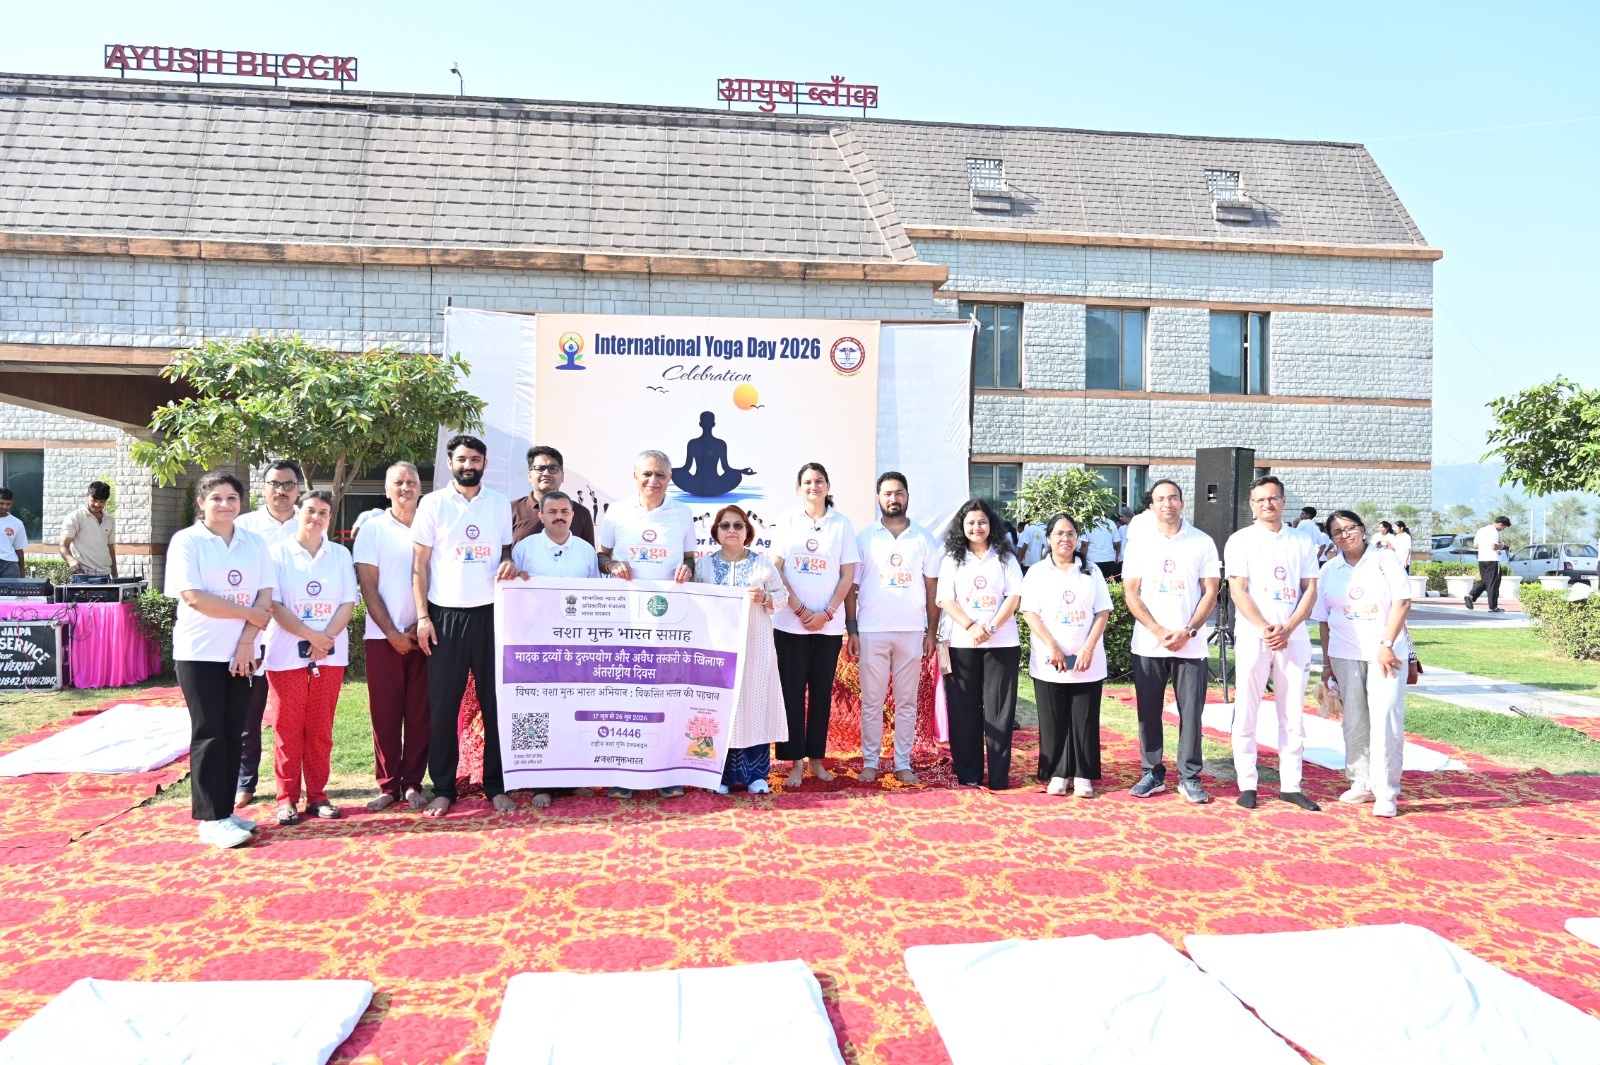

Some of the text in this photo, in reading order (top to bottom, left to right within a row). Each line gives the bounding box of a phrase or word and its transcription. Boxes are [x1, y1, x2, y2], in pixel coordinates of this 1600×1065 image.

[105, 44, 358, 82] AYUSH BLOCK
[718, 78, 795, 113] आयुष
[594, 333, 701, 357] International
[704, 335, 743, 361] Yoga
[747, 336, 777, 361] Day
[779, 337, 821, 360] 2026
[661, 364, 753, 382] Celebration
[630, 547, 668, 560] yoga
[793, 556, 827, 571] yoga
[294, 602, 332, 618] yoga
[1, 627, 32, 637] JALPA
[552, 627, 693, 643] नशा मुक्त भारत सप्ताह
[0, 637, 51, 666] SERVICE
[514, 651, 541, 663] मादक
[542, 649, 562, 663] द्रव्यों
[564, 649, 573, 661] के
[614, 649, 631, 663] और
[632, 649, 655, 664] अवैध
[656, 650, 681, 664] तस्करी
[682, 651, 693, 664] के
[693, 651, 726, 668] खिलाफ
[4, 660, 35, 675] VERMA
[632, 665, 657, 680] दिवस
[515, 685, 539, 697] विषय:
[542, 688, 559, 697] नशा
[560, 688, 575, 699] मुक्त
[577, 688, 597, 697] भारत
[598, 686, 628, 697] अभियान
[635, 687, 665, 699] विकसित
[666, 689, 682, 698] भारत
[684, 687, 694, 698] की
[696, 690, 721, 701] पहचान
[609, 727, 642, 739] 14446
